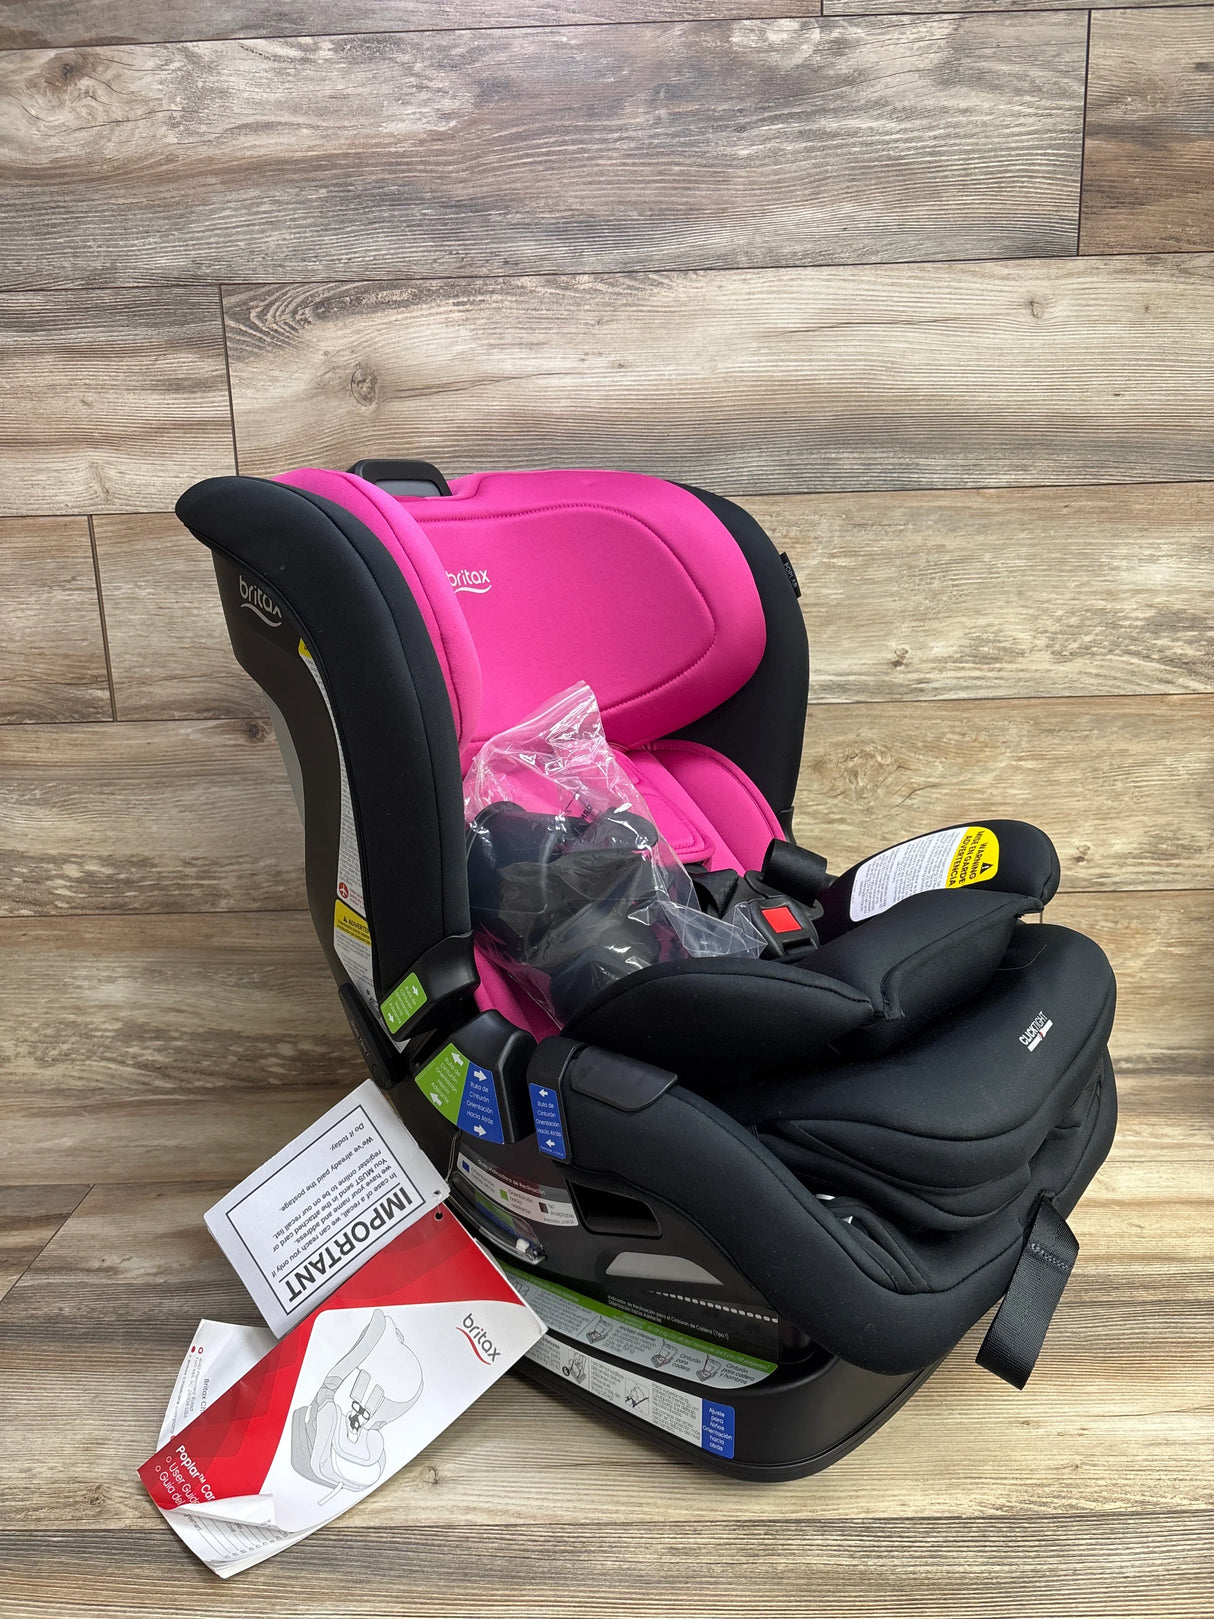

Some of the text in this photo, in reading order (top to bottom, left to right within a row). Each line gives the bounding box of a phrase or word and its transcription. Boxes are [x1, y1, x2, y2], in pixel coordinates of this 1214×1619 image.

[445, 569, 491, 586] britax
[949, 836, 972, 886] ADVERTENCIA
[959, 830, 985, 884] MISE EN GARDE
[969, 842, 988, 880] WARNING
[1019, 1011, 1048, 1045] CLICKTIGHT
[466, 1100, 493, 1114] Orientación
[467, 1110, 480, 1120] Hacia
[354, 1122, 364, 1132] Do
[329, 1134, 348, 1151] today.
[357, 1149, 381, 1170] register
[373, 1158, 387, 1168] You
[279, 1136, 373, 1211] We've already paid the postage.
[337, 1169, 356, 1185] online
[355, 1167, 374, 1185] MUST
[338, 1182, 354, 1198] send
[373, 1177, 388, 1191] case
[312, 1197, 321, 1206] on
[321, 1190, 331, 1199] be
[365, 1190, 373, 1199] of
[294, 1164, 391, 1243] we have your name and address.
[302, 1204, 312, 1216] our
[320, 1200, 332, 1211] the
[340, 1200, 360, 1217] recall,
[284, 1214, 301, 1231] recall
[293, 1209, 320, 1234] attached
[331, 1216, 341, 1225] we
[272, 1228, 284, 1239] list.
[318, 1224, 330, 1236] can
[279, 1232, 293, 1246] card
[284, 1186, 412, 1302] IMPORTANT
[300, 1234, 319, 1250] reach
[272, 1243, 279, 1252] or
[289, 1248, 301, 1261] you
[276, 1259, 289, 1272] only
[463, 1313, 501, 1362] britax
[675, 1358, 689, 1368] para
[679, 1352, 702, 1365] Cinturón
[672, 1362, 691, 1372] cadera
[725, 1362, 749, 1374] Cinturón
[721, 1368, 755, 1381] para cadera
[709, 1408, 725, 1417] Ajuste
[711, 1416, 723, 1424] para
[703, 1425, 732, 1440] Orientación
[710, 1434, 724, 1444] hacia
[169, 1462, 186, 1484] User
[201, 1484, 216, 1501] Car
